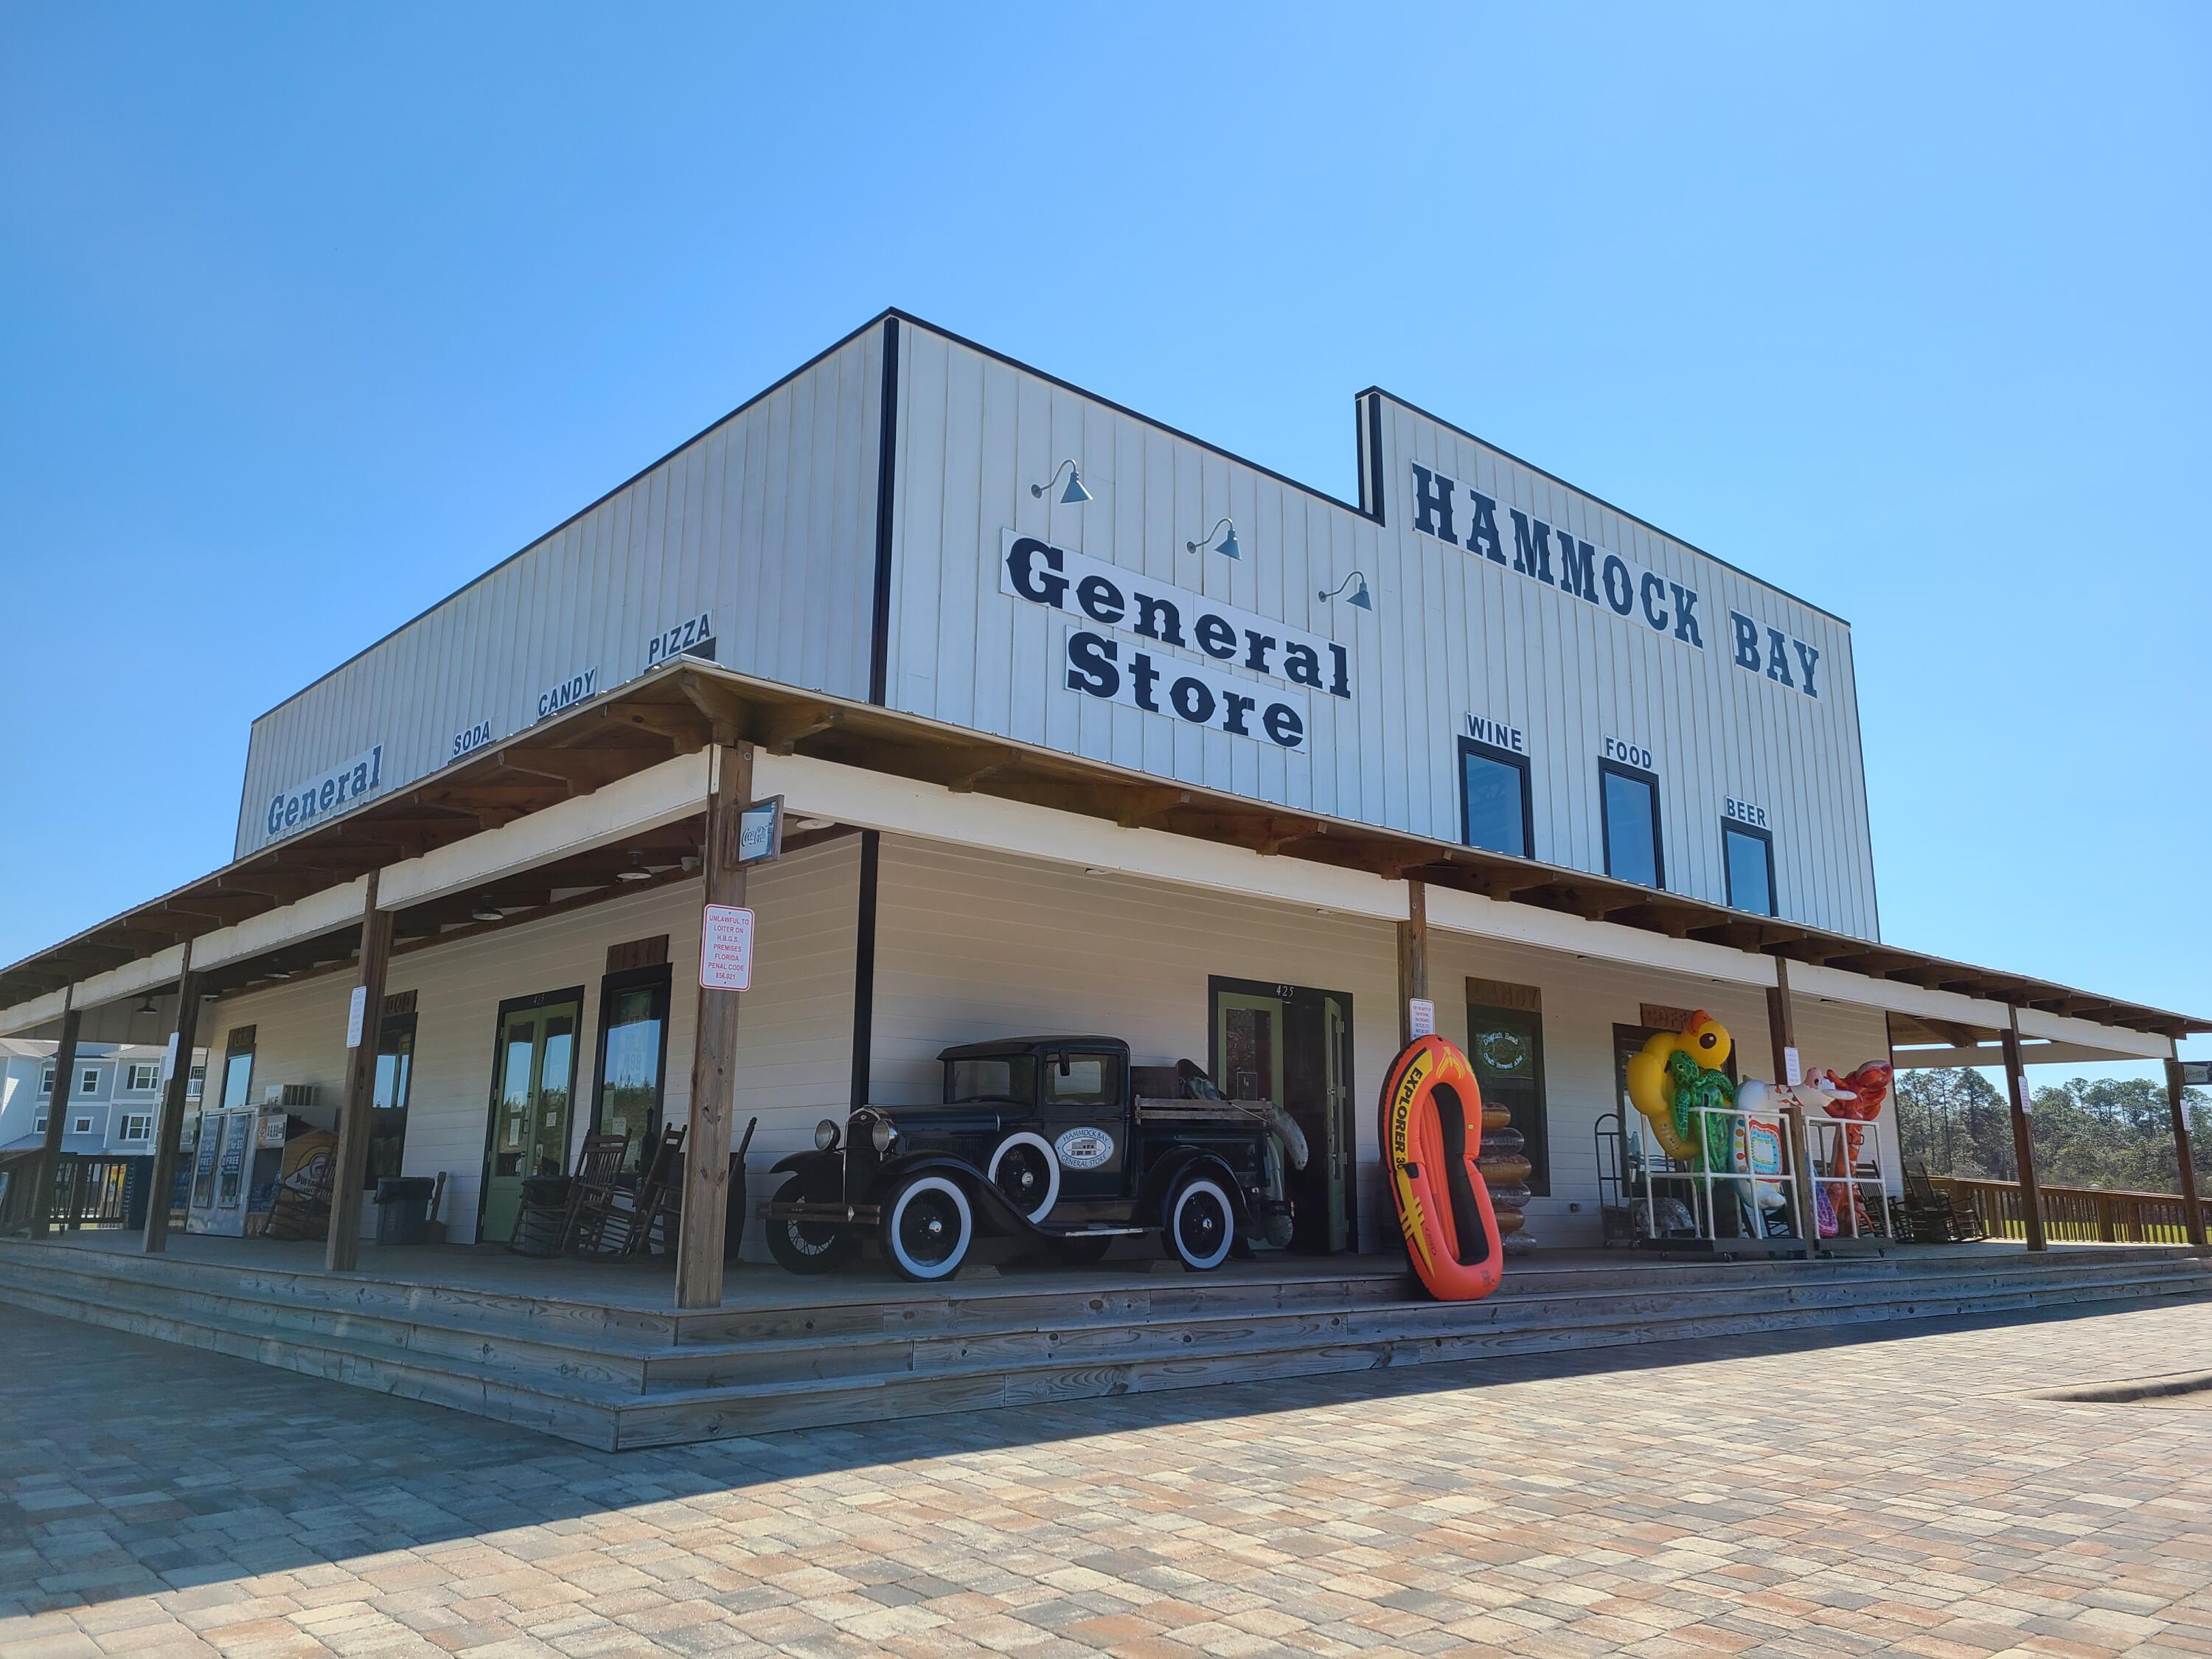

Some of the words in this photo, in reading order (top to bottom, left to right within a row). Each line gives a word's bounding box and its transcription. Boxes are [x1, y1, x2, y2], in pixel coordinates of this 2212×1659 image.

[1412, 464, 1703, 649] HAMMOCK
[1730, 610, 1820, 698] BAY
[1006, 538, 1351, 699] General
[648, 613, 711, 664] PIZZA
[538, 668, 595, 717] CANDY
[1067, 631, 1304, 748] Store
[453, 720, 490, 756] SODA
[1467, 712, 1523, 752] WINE
[1605, 737, 1652, 769] FOOD
[268, 745, 382, 828] General
[1726, 797, 1767, 827] BEER
[709, 914, 740, 925] UNLAWFUL
[713, 925, 734, 933] LOITER
[713, 943, 742, 953] PREMISES
[714, 953, 740, 962] FLORIDA
[708, 961, 727, 970] PENAL
[728, 964, 745, 972] CODE
[715, 972, 736, 980] 856.021
[1276, 984, 1295, 998] 425
[1394, 1067, 1423, 1154] EXPLORER
[1062, 1129, 1096, 1142] HAMMOCK
[1097, 1132, 1109, 1143] BAY
[1061, 1155, 1088, 1166] GENERAL
[1089, 1154, 1107, 1166] STORE
